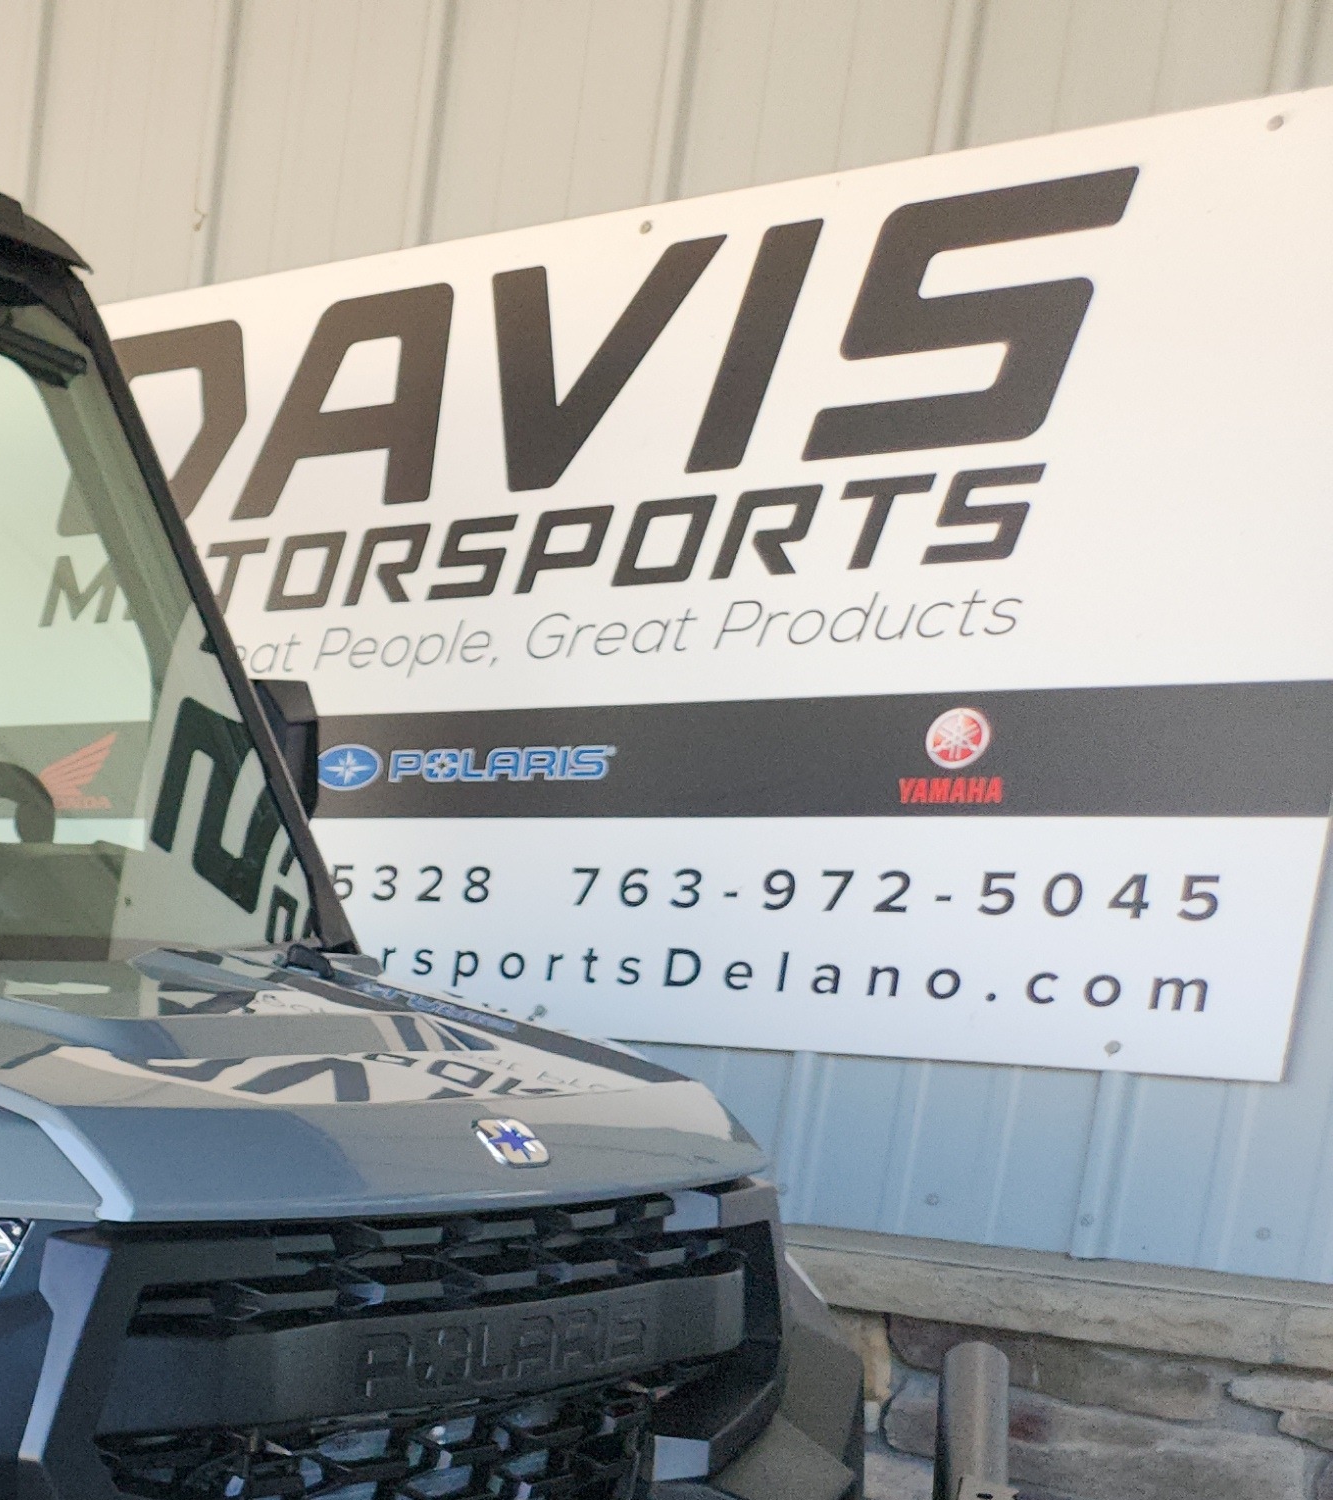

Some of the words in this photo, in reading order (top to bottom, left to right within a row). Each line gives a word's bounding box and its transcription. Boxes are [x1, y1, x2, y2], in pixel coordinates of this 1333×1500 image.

[56, 166, 1139, 537] DAVIS
[39, 463, 1046, 628] MTORSPORTS
[313, 619, 498, 678] People,
[526, 607, 698, 661] Great
[712, 589, 1024, 650] Products
[388, 745, 612, 783] POLARIS
[898, 776, 1004, 804] YAMAHA
[333, 864, 493, 903] 5328
[571, 866, 1223, 921] 763-972-5045
[380, 944, 1210, 1013] rsportsDelano.com
